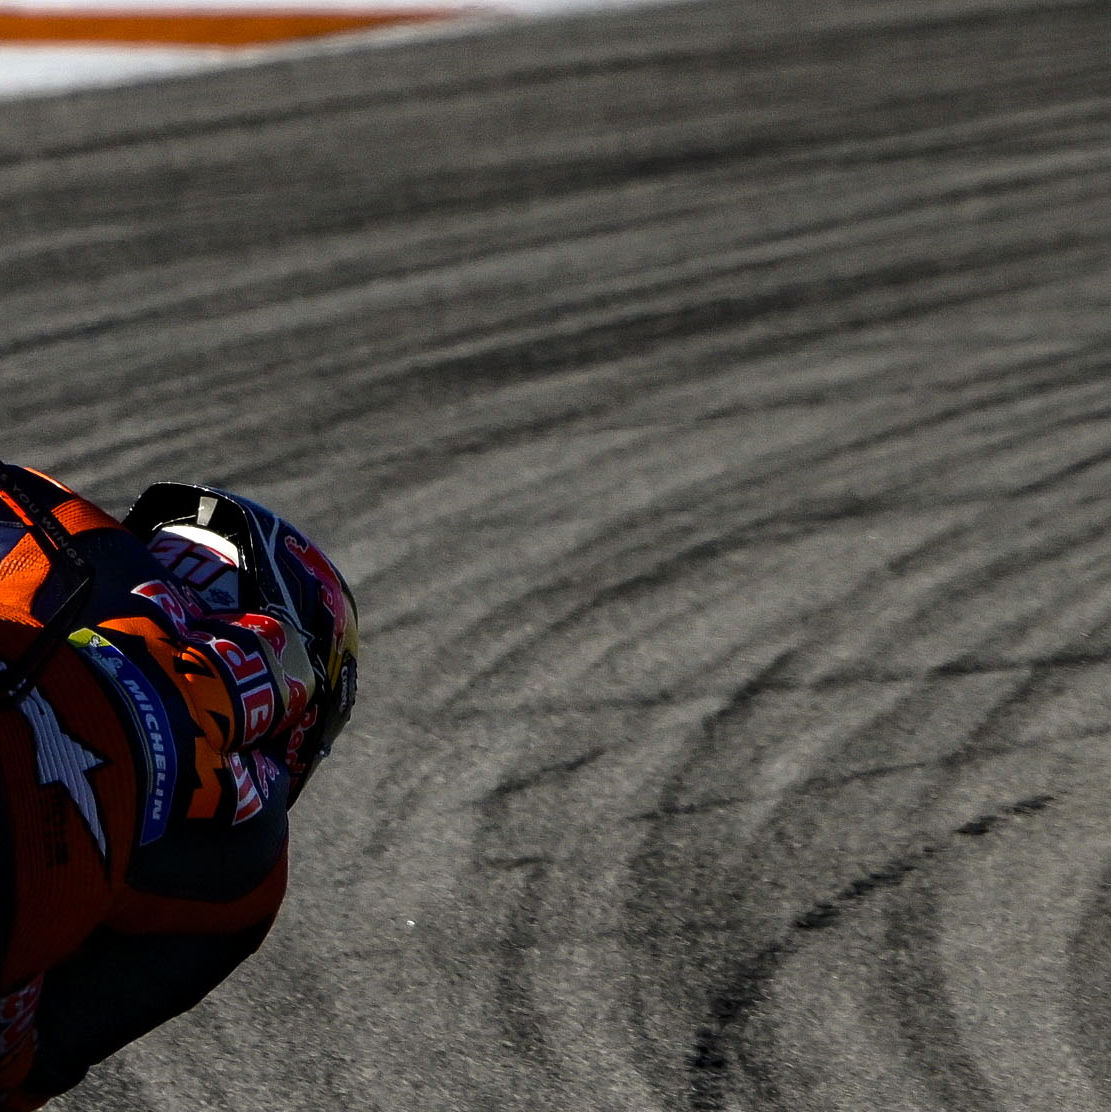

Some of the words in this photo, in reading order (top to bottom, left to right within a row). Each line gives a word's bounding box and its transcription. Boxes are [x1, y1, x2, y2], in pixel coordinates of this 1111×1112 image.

[12, 481, 40, 514] YOU
[41, 515, 86, 568] WINGS
[122, 679, 167, 821] MICHELIN
